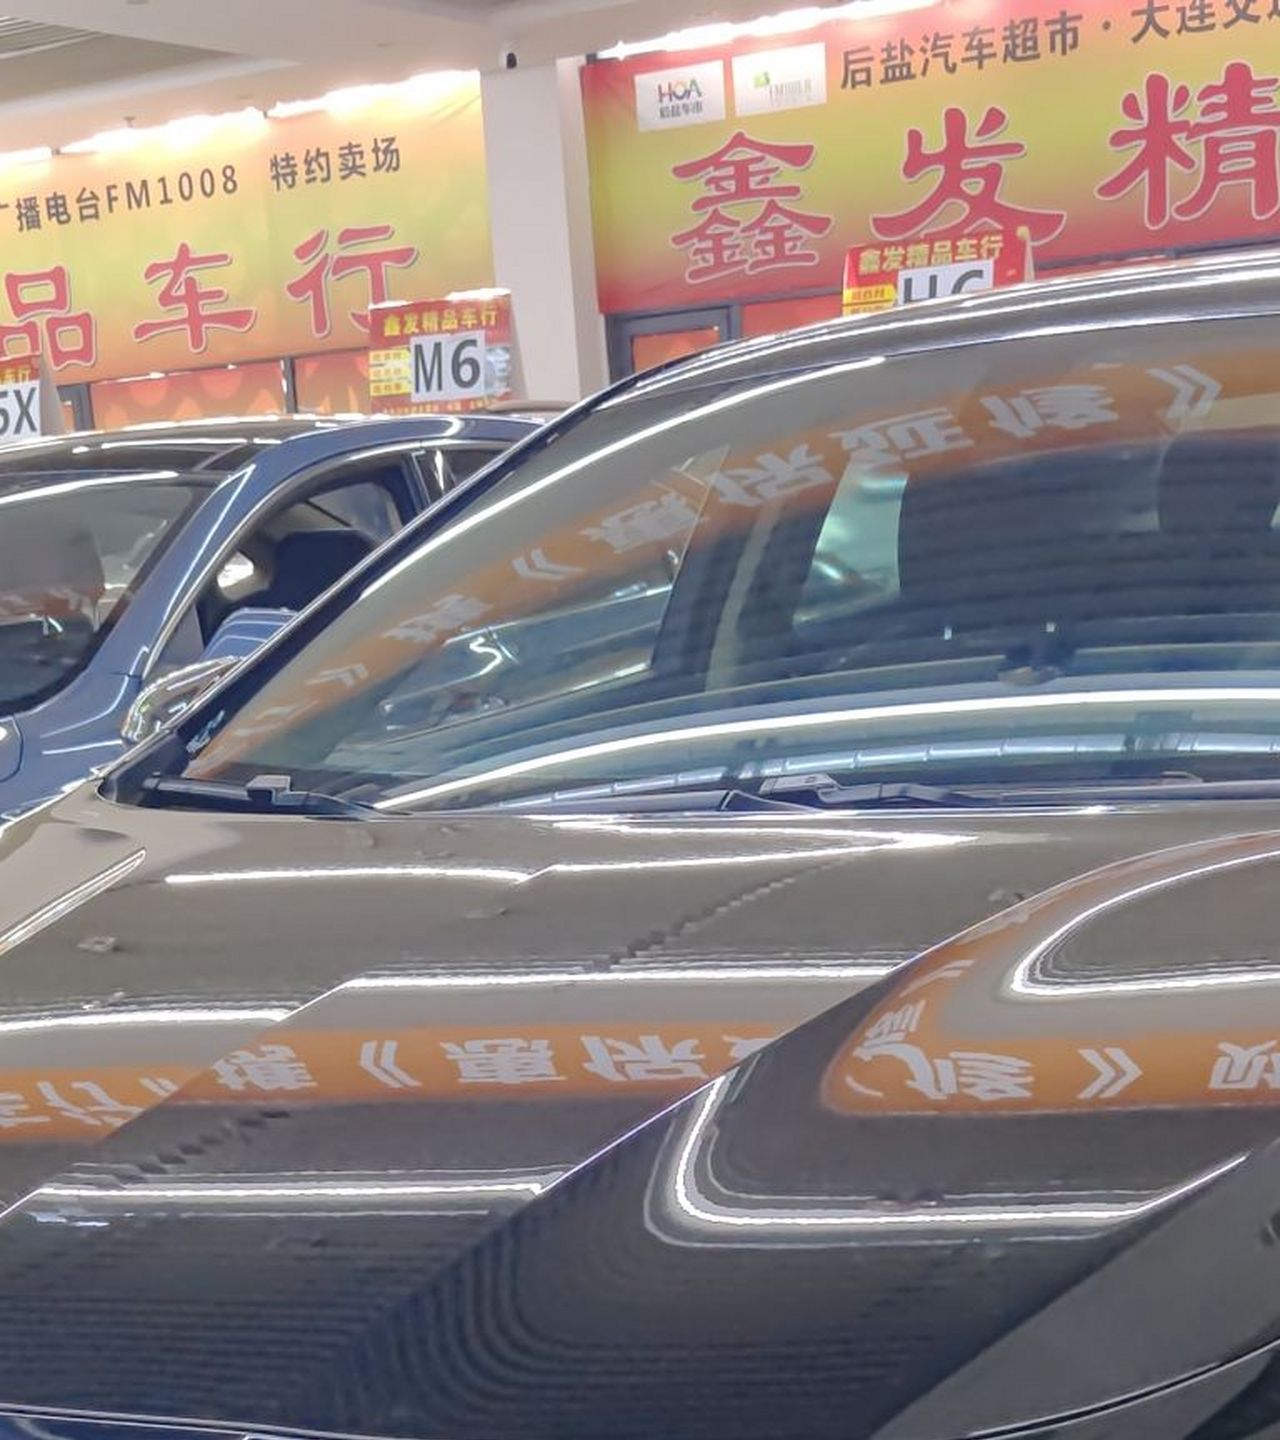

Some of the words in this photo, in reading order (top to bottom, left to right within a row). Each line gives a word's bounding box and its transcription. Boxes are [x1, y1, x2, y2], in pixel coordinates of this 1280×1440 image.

[270, 136, 401, 191] 特约卖场
[414, 338, 481, 393] M6
